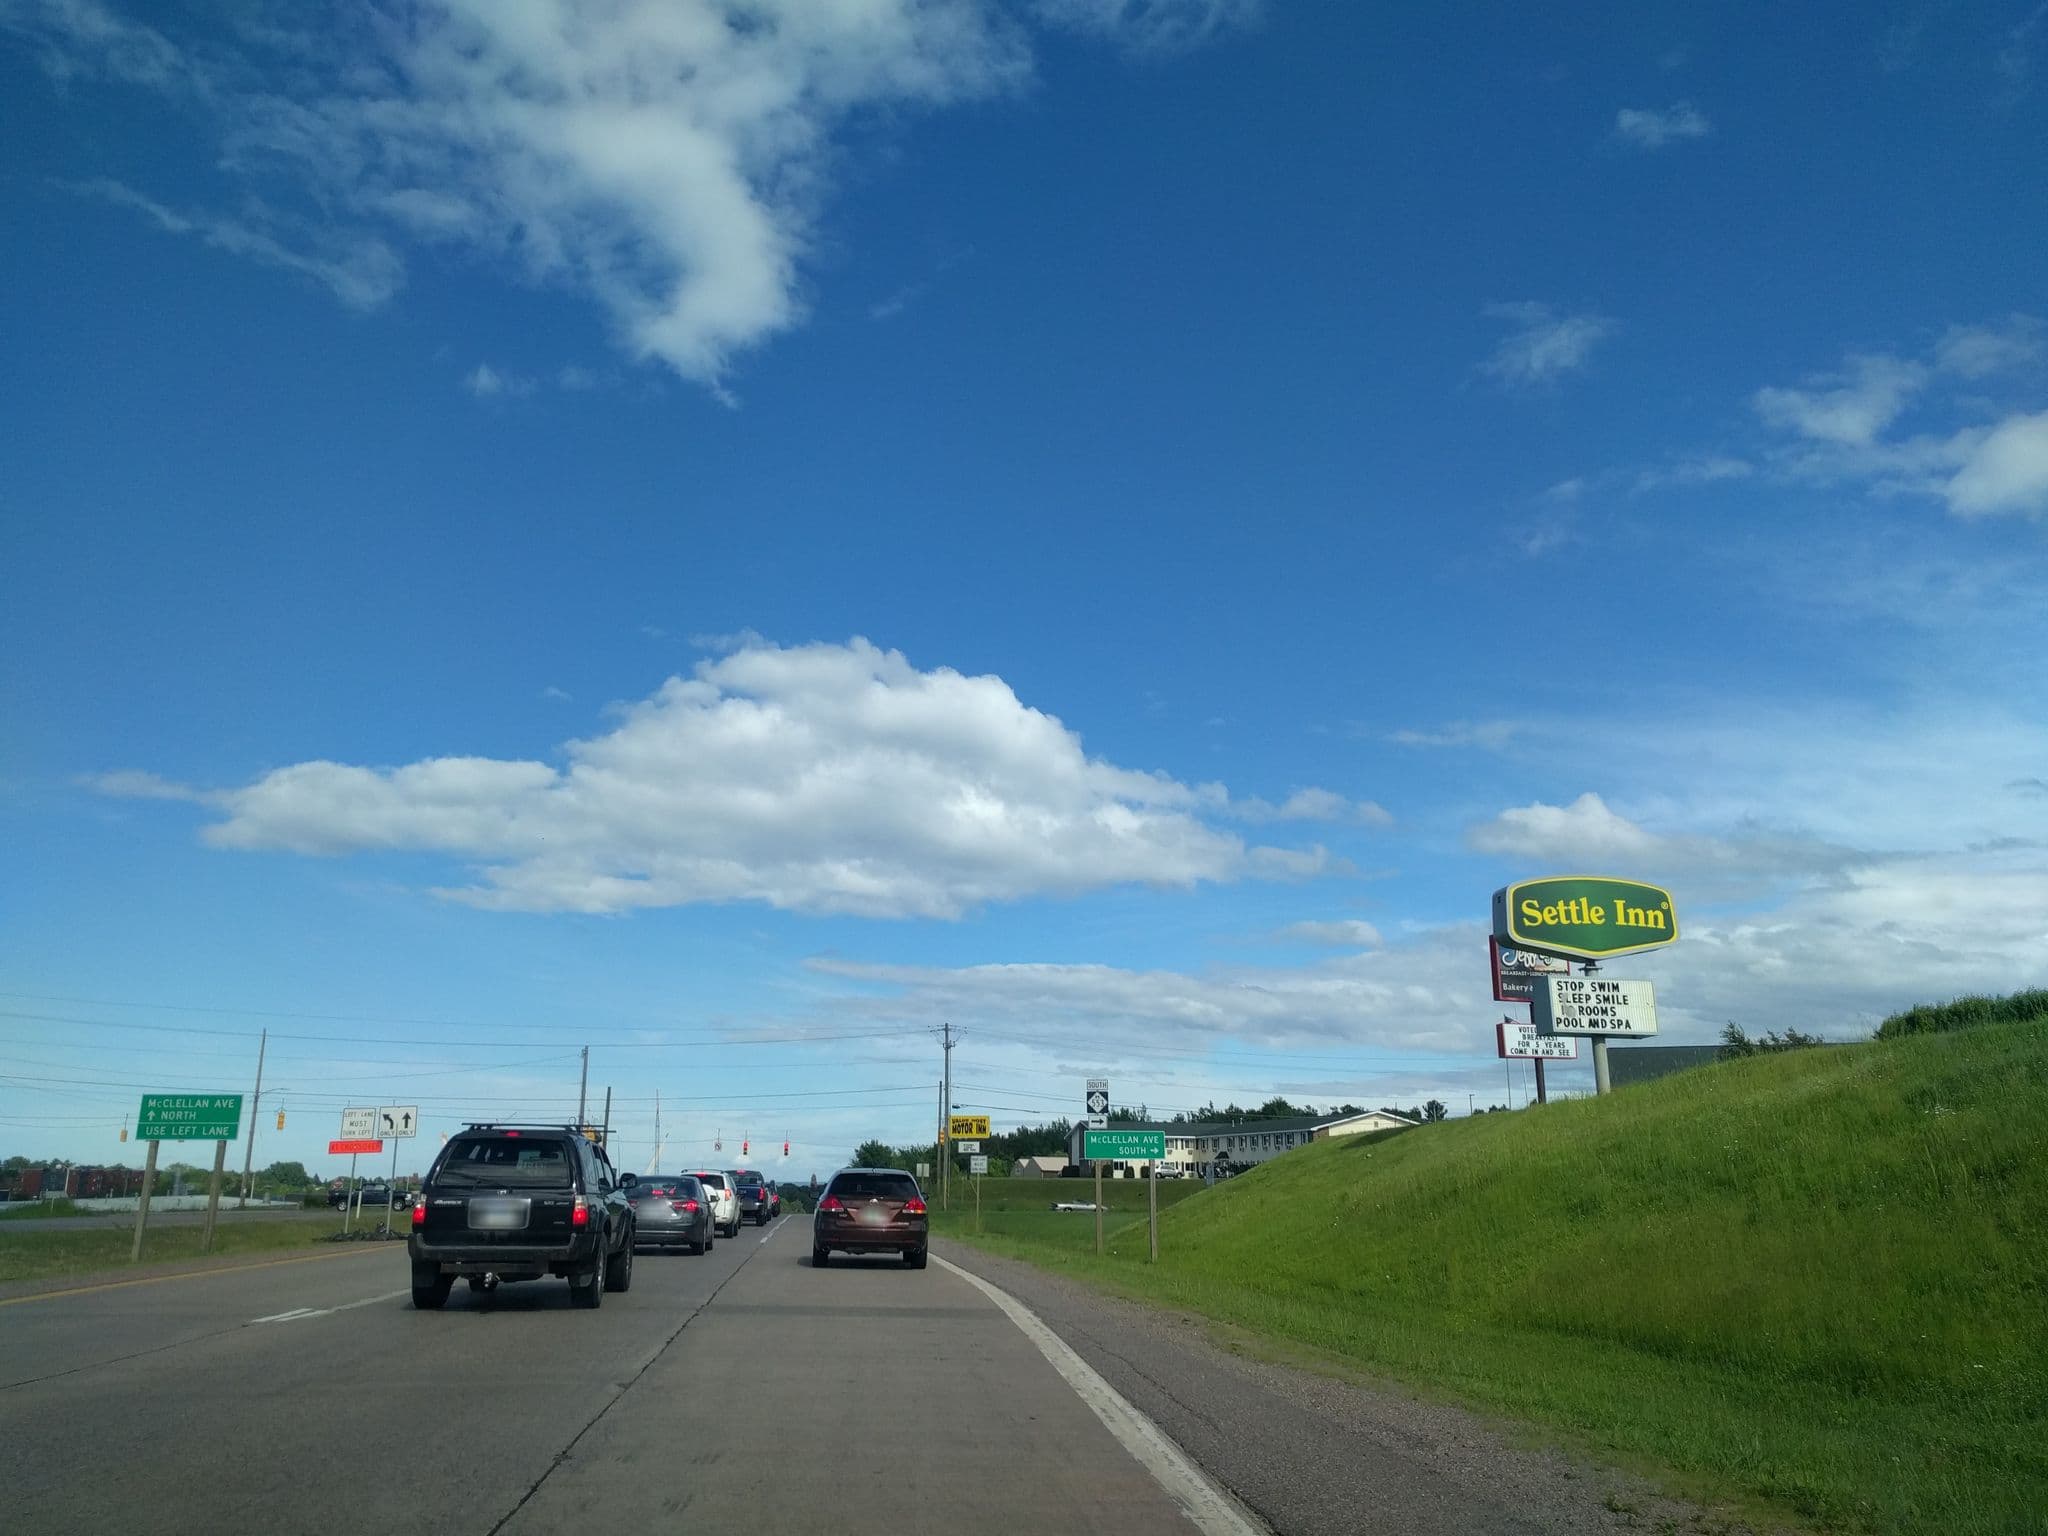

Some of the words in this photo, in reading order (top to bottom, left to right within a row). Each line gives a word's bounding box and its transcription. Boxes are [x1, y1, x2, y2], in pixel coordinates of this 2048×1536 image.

[1521, 896, 1605, 926] Settle
[1613, 899, 1666, 929] Inn
[1503, 983, 1529, 992] Bakery
[1557, 981, 1584, 991] STOP
[1591, 982, 1620, 992] SWIM
[1596, 994, 1629, 1005] SMILE
[1578, 1006, 1617, 1016] ROOMS
[1556, 1018, 1585, 1028] POOL
[1588, 1018, 1608, 1029] AND
[1610, 1019, 1632, 1029] SPA
[1558, 1049, 1570, 1057] SEE
[1088, 1081, 1107, 1089] SOUTH
[148, 1099, 209, 1108] McCLELLAN
[214, 1099, 235, 1108] AVE
[1092, 1099, 1104, 1107] 553
[161, 1111, 196, 1120] NORTH
[146, 1126, 166, 1136] USE
[172, 1126, 197, 1136] LEFT
[203, 1126, 229, 1136] LANE
[952, 1123, 973, 1134] MOTOR
[976, 1124, 987, 1134] INN
